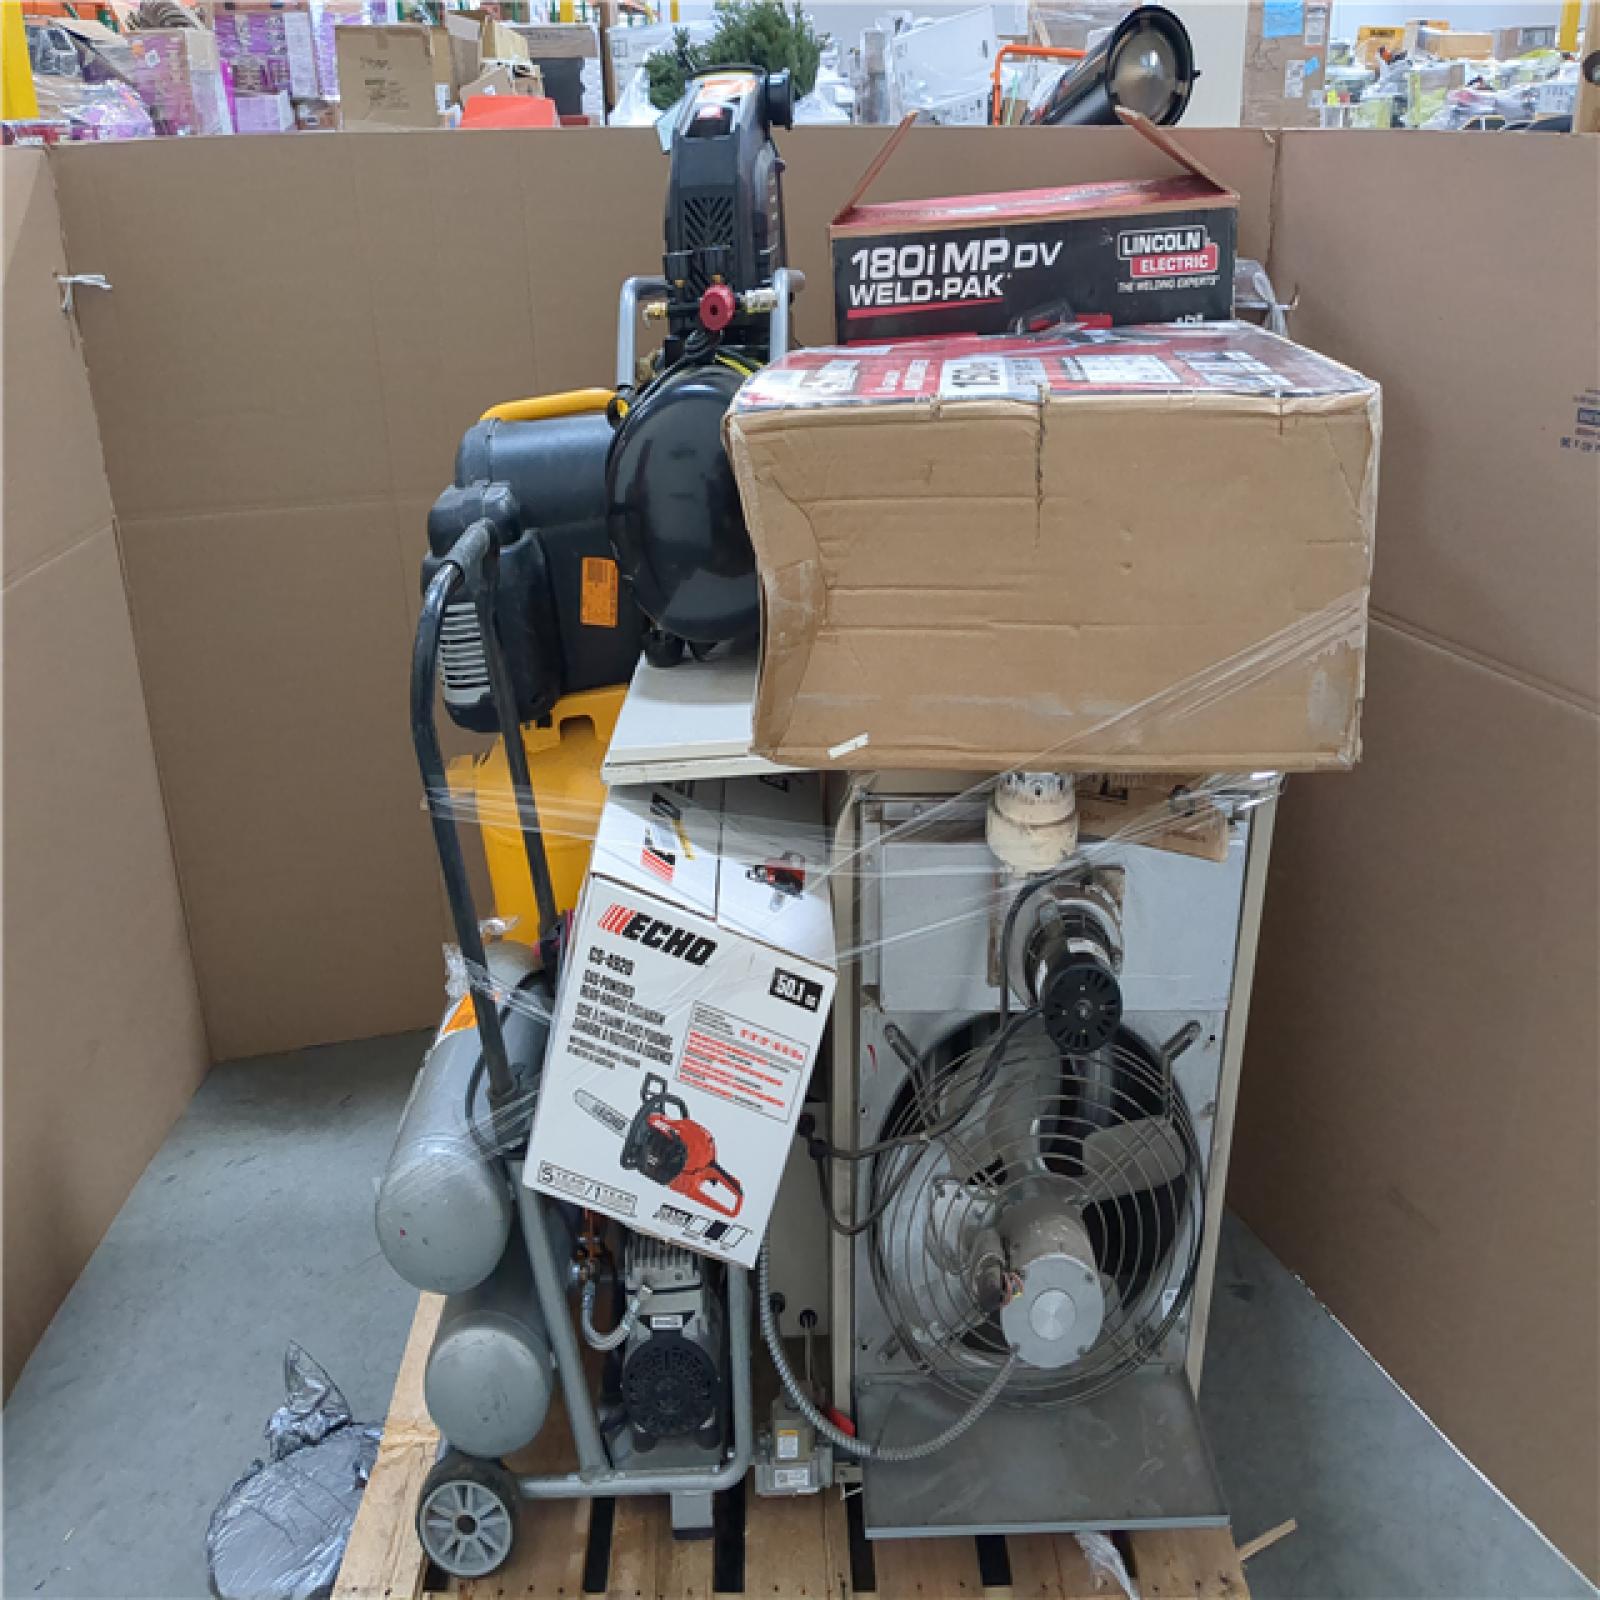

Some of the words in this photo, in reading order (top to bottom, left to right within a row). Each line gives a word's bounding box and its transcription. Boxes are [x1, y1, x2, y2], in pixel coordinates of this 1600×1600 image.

[851, 243, 936, 281] 180i
[942, 238, 1010, 274] MP
[1014, 240, 1064, 268] DV
[1122, 231, 1201, 256] LINCOLN
[1141, 254, 1208, 273] ELECTRIC
[622, 911, 718, 966] ECHO
